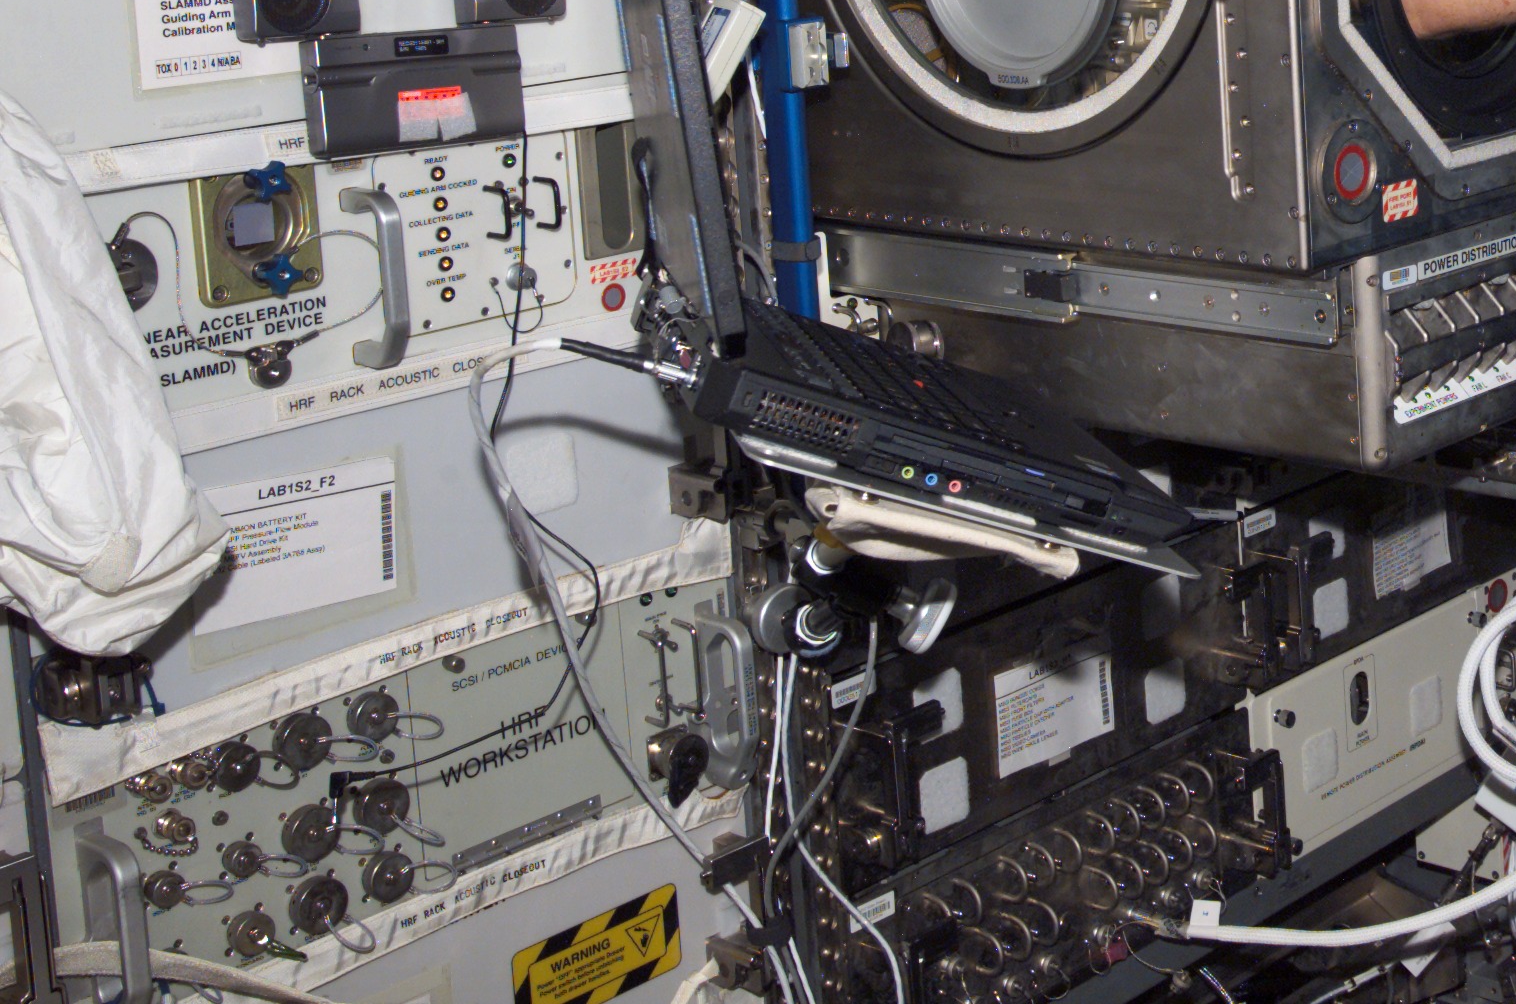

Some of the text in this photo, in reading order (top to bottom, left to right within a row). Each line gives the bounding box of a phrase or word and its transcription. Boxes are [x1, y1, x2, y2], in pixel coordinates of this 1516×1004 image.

[161, 9, 231, 24] Guiding Arm
[162, 23, 223, 38] Calibration
[156, 62, 172, 74] TOX
[278, 137, 305, 150] HRF
[495, 143, 520, 153] POWER
[424, 155, 448, 165] READY
[448, 179, 478, 191] COCKED
[408, 209, 474, 228] COLLECTING DATA
[418, 241, 470, 258] SENDING DATA
[1424, 253, 1459, 275] POWER
[426, 277, 446, 288] OVER
[200, 296, 327, 334] ACCELERATION
[265, 312, 324, 336] DEVICE
[160, 359, 236, 388] SLAMMD)
[289, 396, 315, 413] HRF
[330, 384, 365, 403] RACK
[378, 367, 440, 391] ACOUSTIC
[258, 475, 336, 500] LAB1S2_F2
[257, 512, 308, 529] BATTERY KIT
[247, 546, 282, 559] Assembly
[379, 607, 529, 665] HRF RACK ACOUSTIC CLOSEOUT
[451, 672, 479, 692] SCSI
[487, 656, 531, 680] PCMCIA
[500, 705, 548, 740] HRF
[1339, 777, 1355, 790] POWER
[1355, 761, 1385, 782] DISTRIBUTION
[401, 915, 418, 929] HRF
[424, 901, 446, 919] RACK
[454, 877, 496, 904] ACOUSTIC
[502, 859, 547, 883] CLOSEOUT
[550, 937, 611, 974] WARNING
